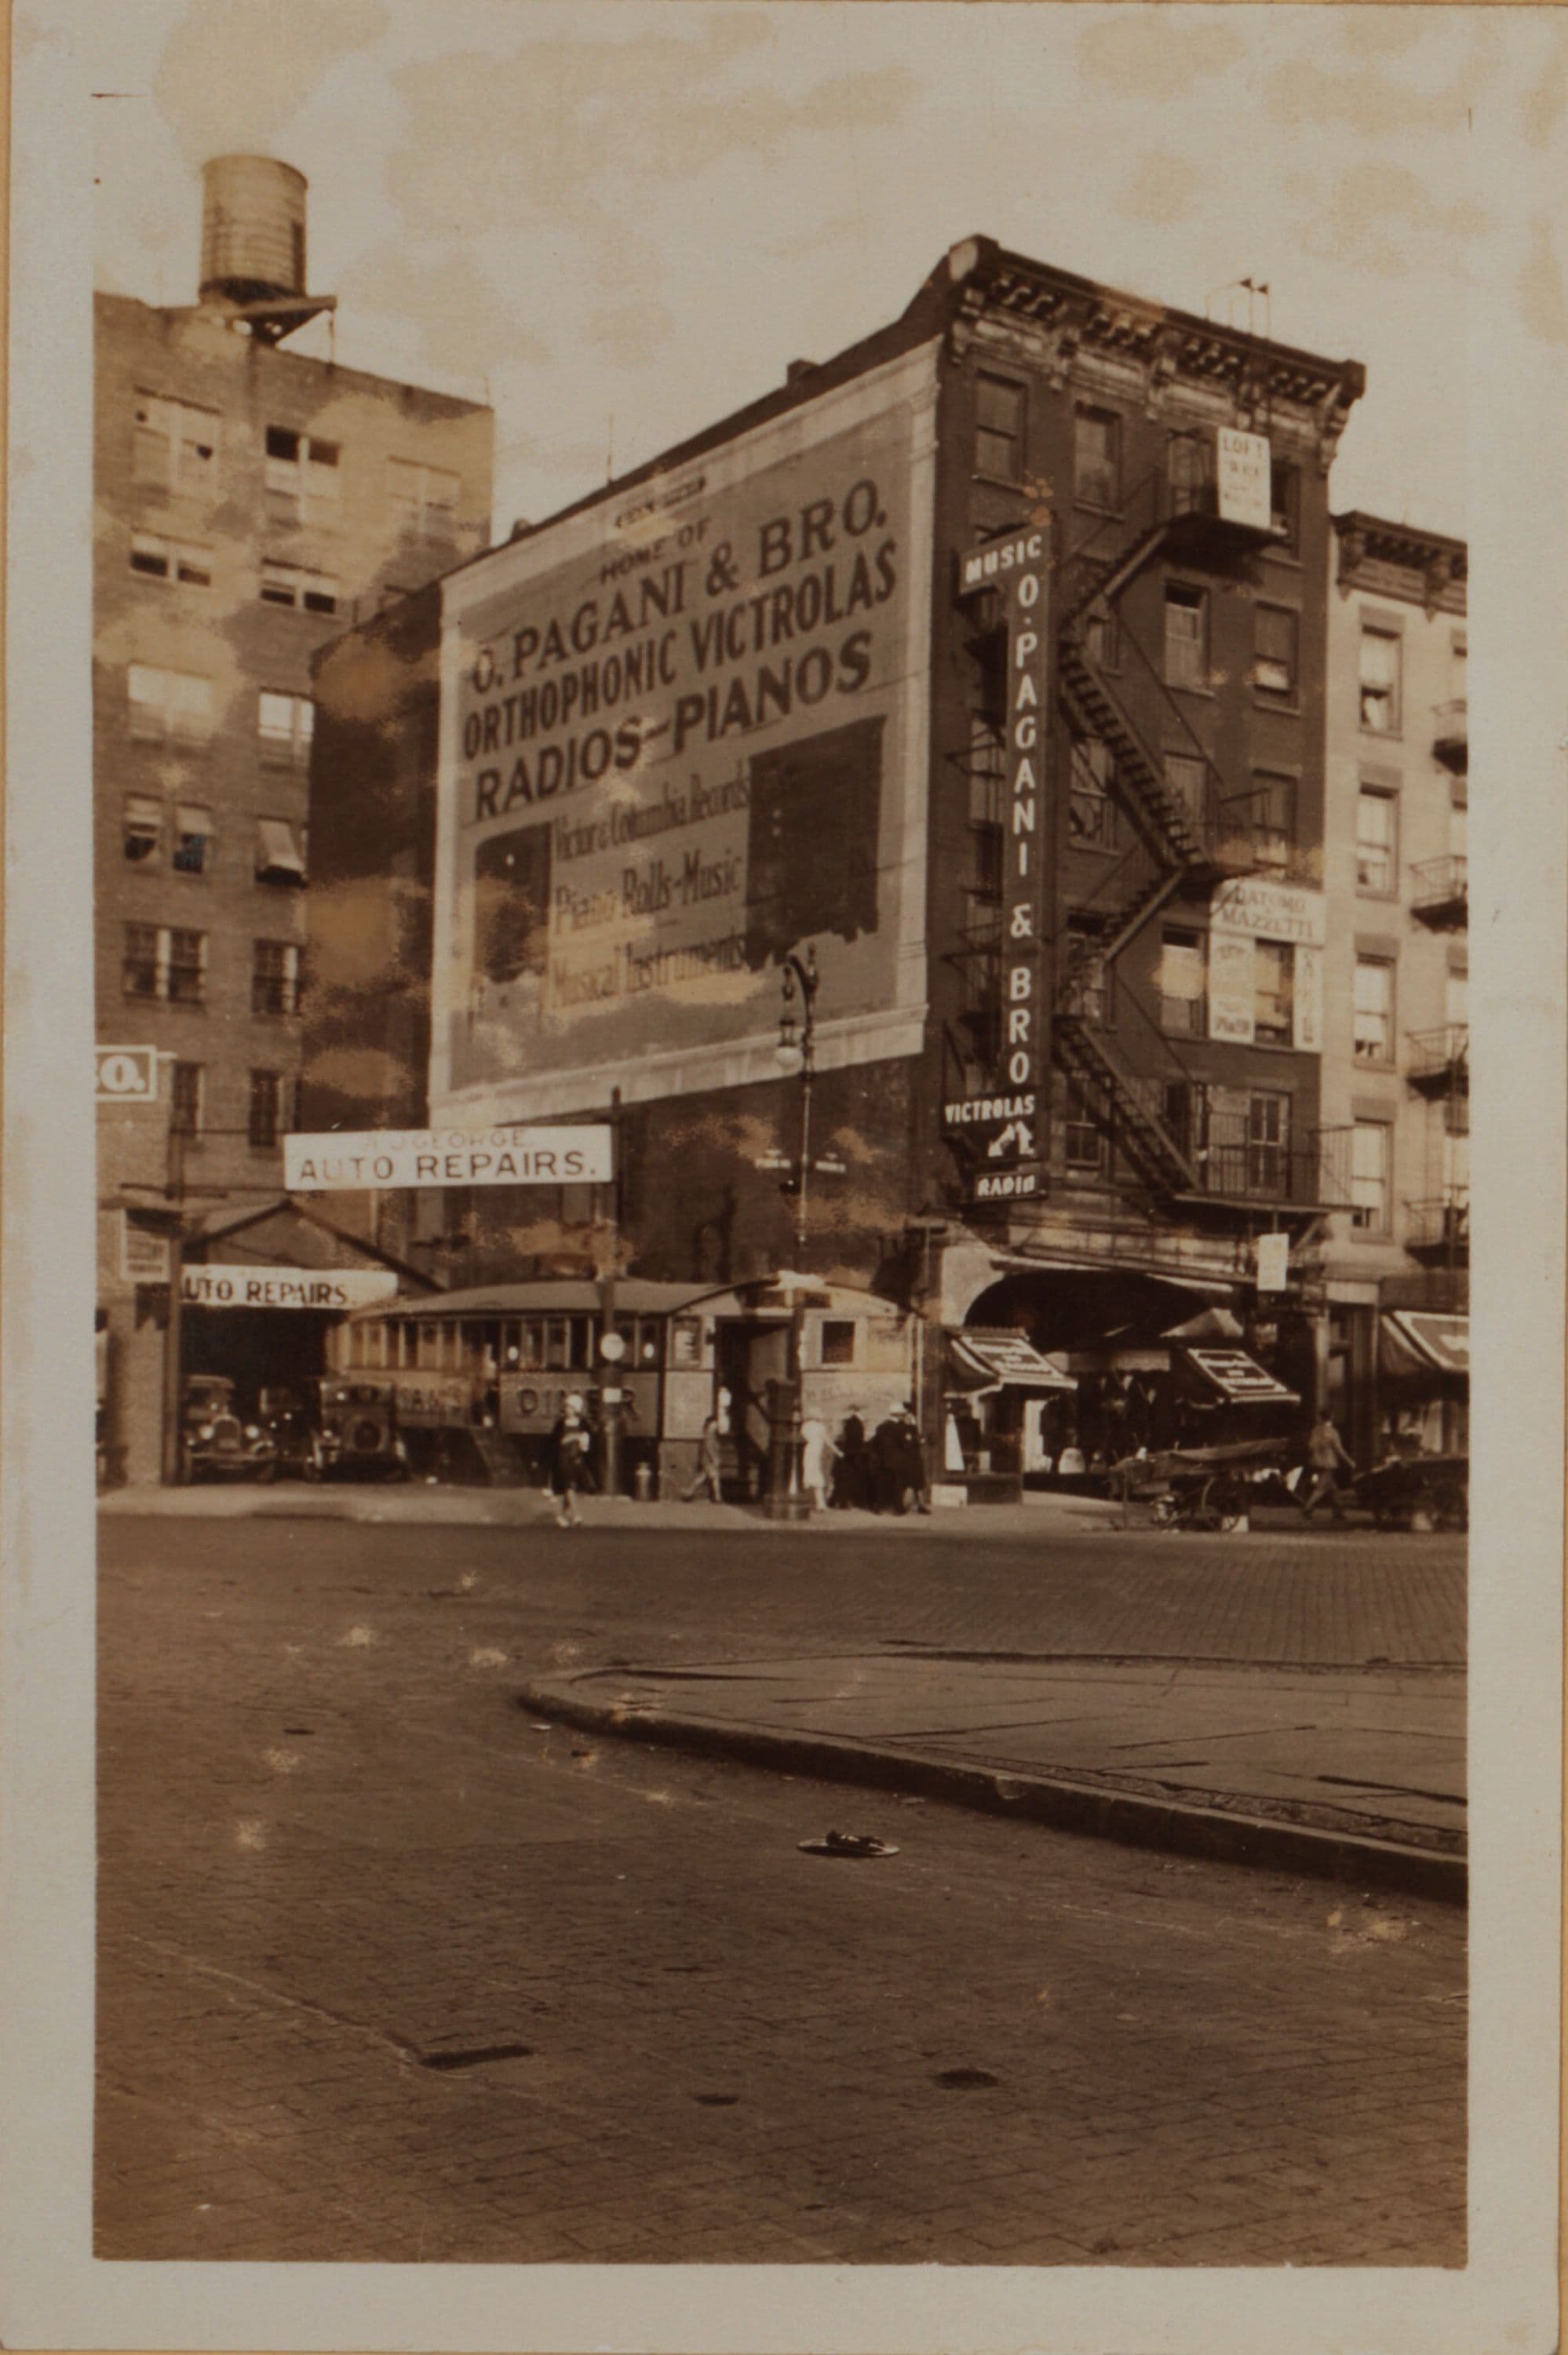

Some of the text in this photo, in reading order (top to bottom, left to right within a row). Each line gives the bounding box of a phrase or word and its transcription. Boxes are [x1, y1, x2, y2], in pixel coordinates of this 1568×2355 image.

[677, 516, 712, 547] OF
[512, 560, 687, 680] PAGANI
[705, 541, 738, 597] &
[758, 479, 888, 578] BRO.
[965, 534, 1042, 584] MUSIC
[463, 536, 898, 761] ORTHOPHONIC VICTROLAS
[1010, 632, 1038, 877] PAGANI
[1011, 903, 1033, 937] &
[1009, 968, 1031, 1084] BRO
[945, 1094, 1035, 1124] VICTROLAS
[300, 1150, 597, 1181] AUTO REPAIRS.
[977, 1175, 1035, 1198] RADIO
